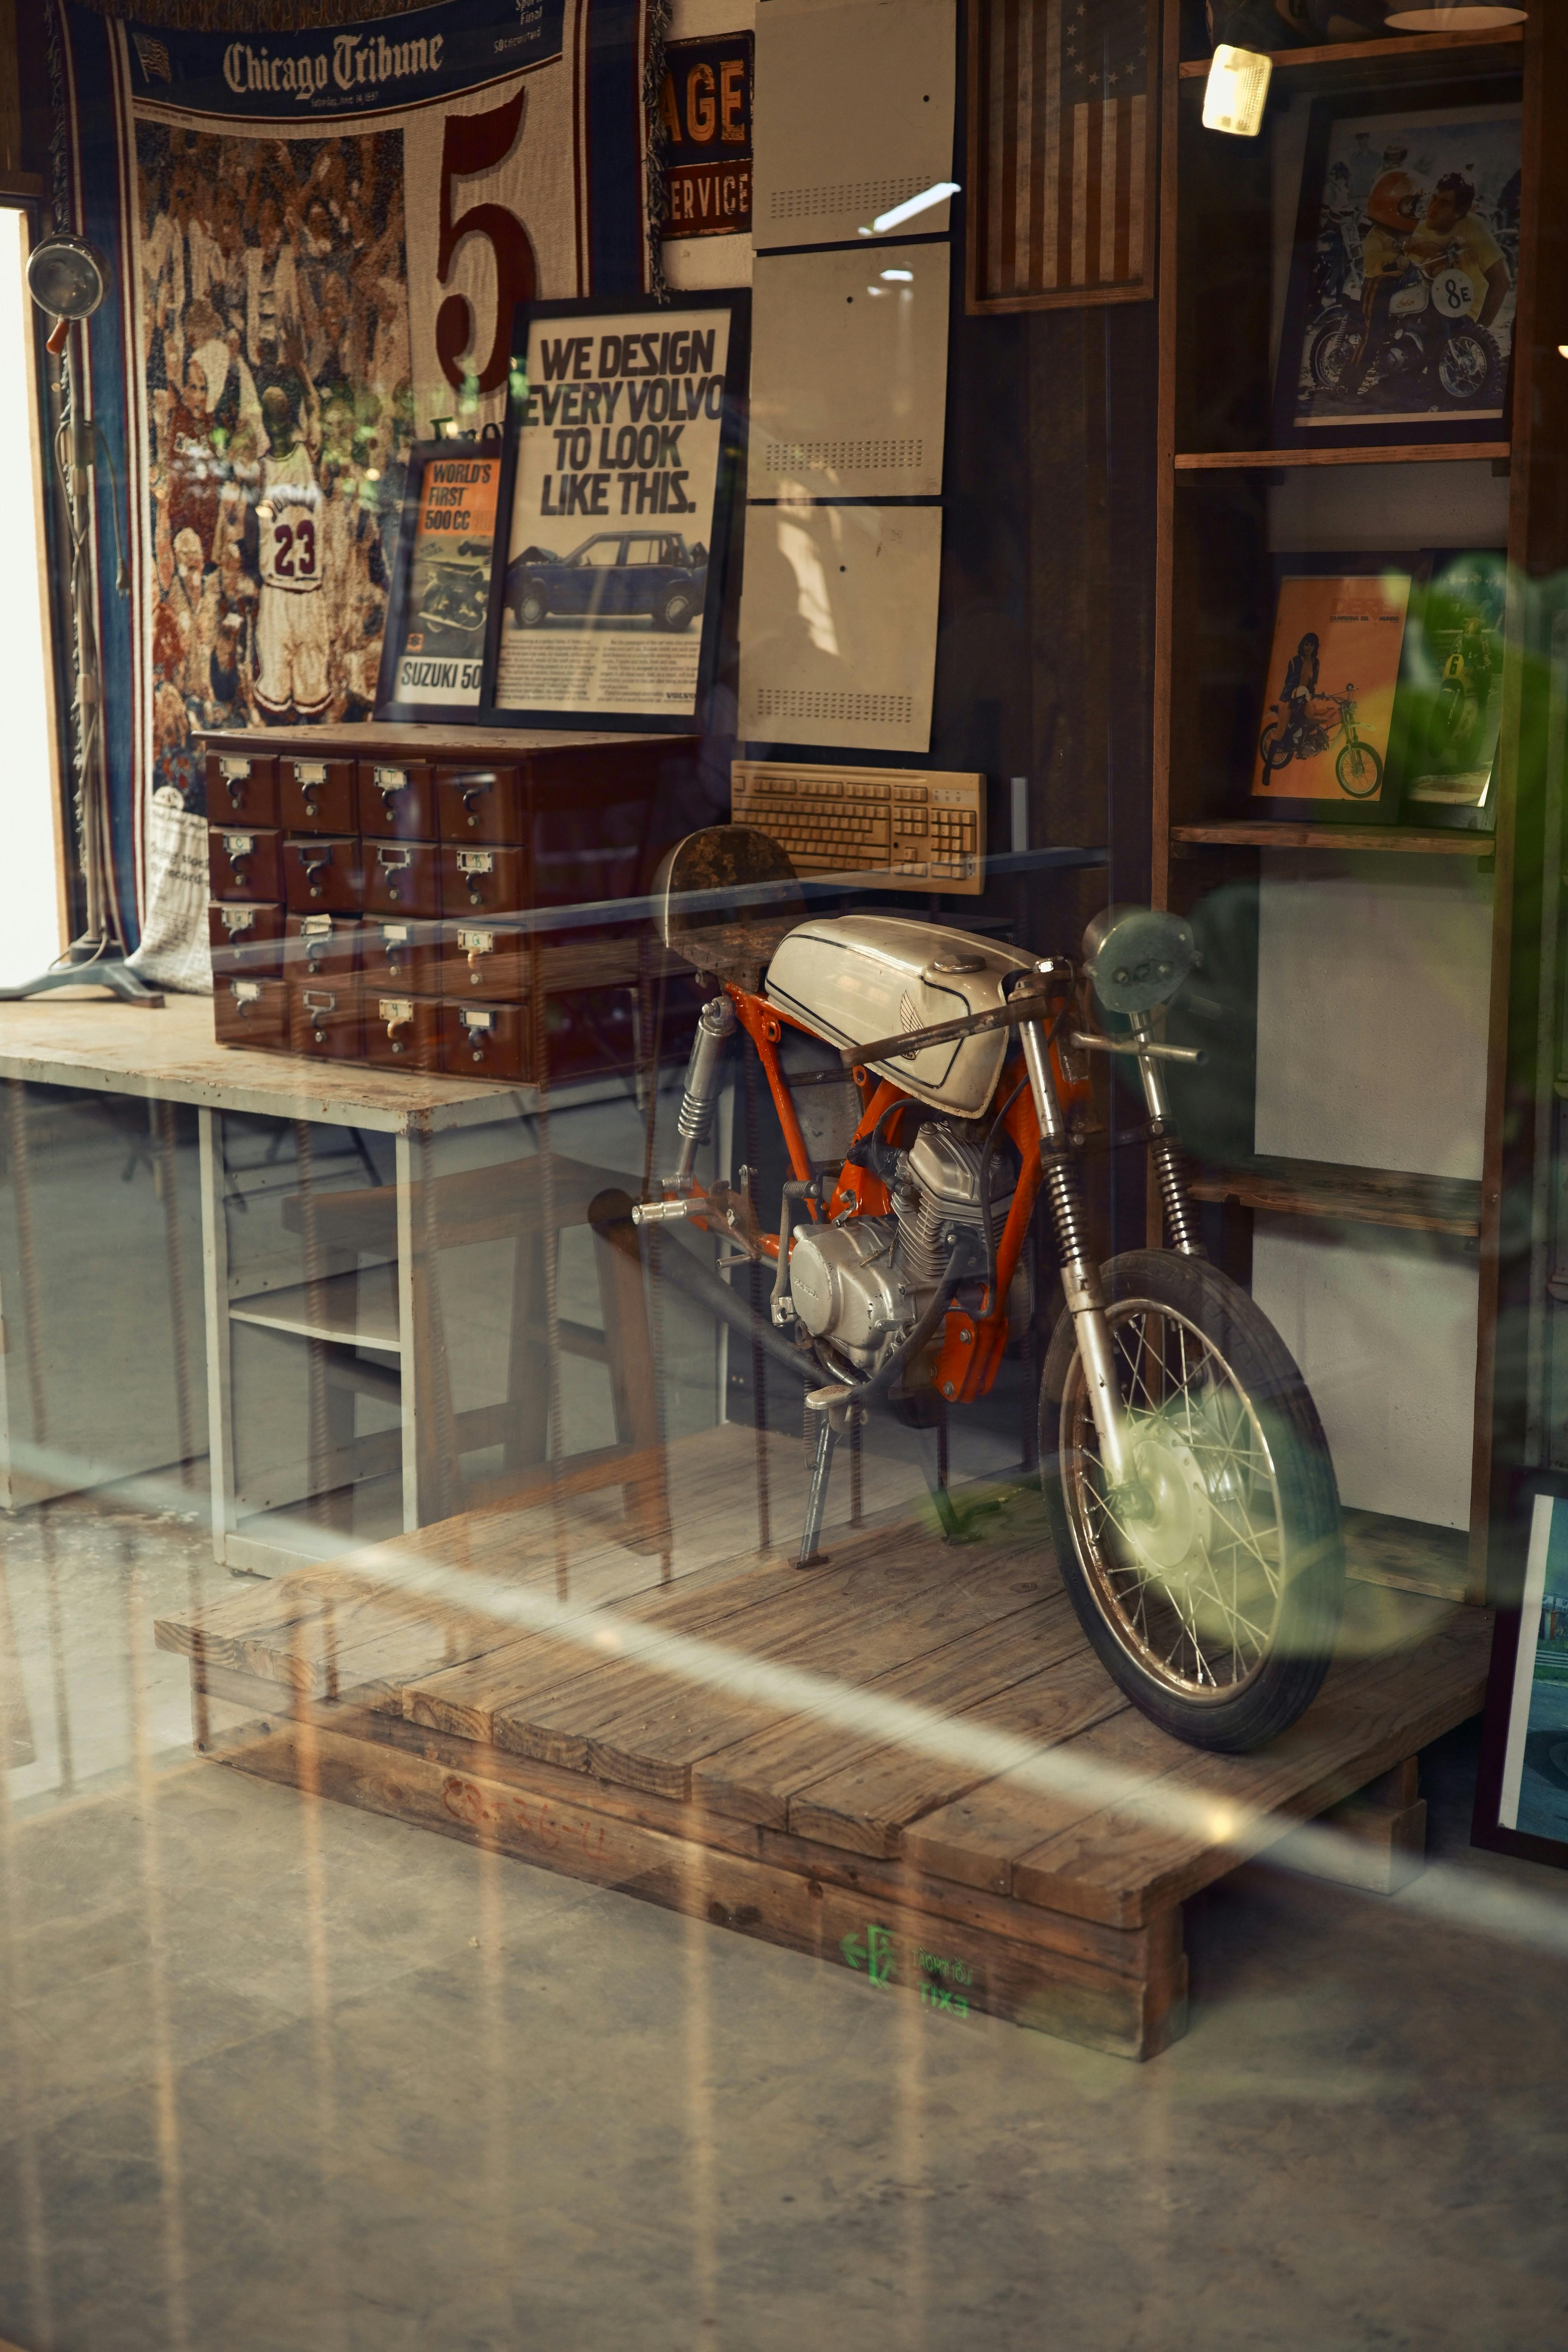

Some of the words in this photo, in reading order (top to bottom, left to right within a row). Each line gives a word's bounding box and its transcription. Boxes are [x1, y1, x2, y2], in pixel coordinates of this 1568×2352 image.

[520, 6, 542, 24] Final
[223, 41, 327, 100] Chicago
[332, 33, 444, 90] Tribune
[660, 59, 745, 141] AGE
[671, 173, 749, 220] ERVICE
[435, 85, 537, 394] 5
[541, 336, 593, 381] WE
[598, 329, 715, 379] DESIGN
[522, 381, 624, 426] EVERY
[627, 374, 725, 423] VOLVO
[553, 427, 592, 471] TO
[598, 424, 686, 469] LOOK
[429, 486, 468, 507] FIRST
[433, 463, 491, 484] WORLD'S
[540, 472, 610, 516] LIKE
[617, 471, 696, 514] THIS.
[275, 520, 315, 576] 23
[401, 661, 458, 688] SUZUKI
[461, 664, 482, 689] 50
[1449, 656, 1459, 676] 6
[387, 770, 395, 783] T
[235, 837, 244, 850] C
